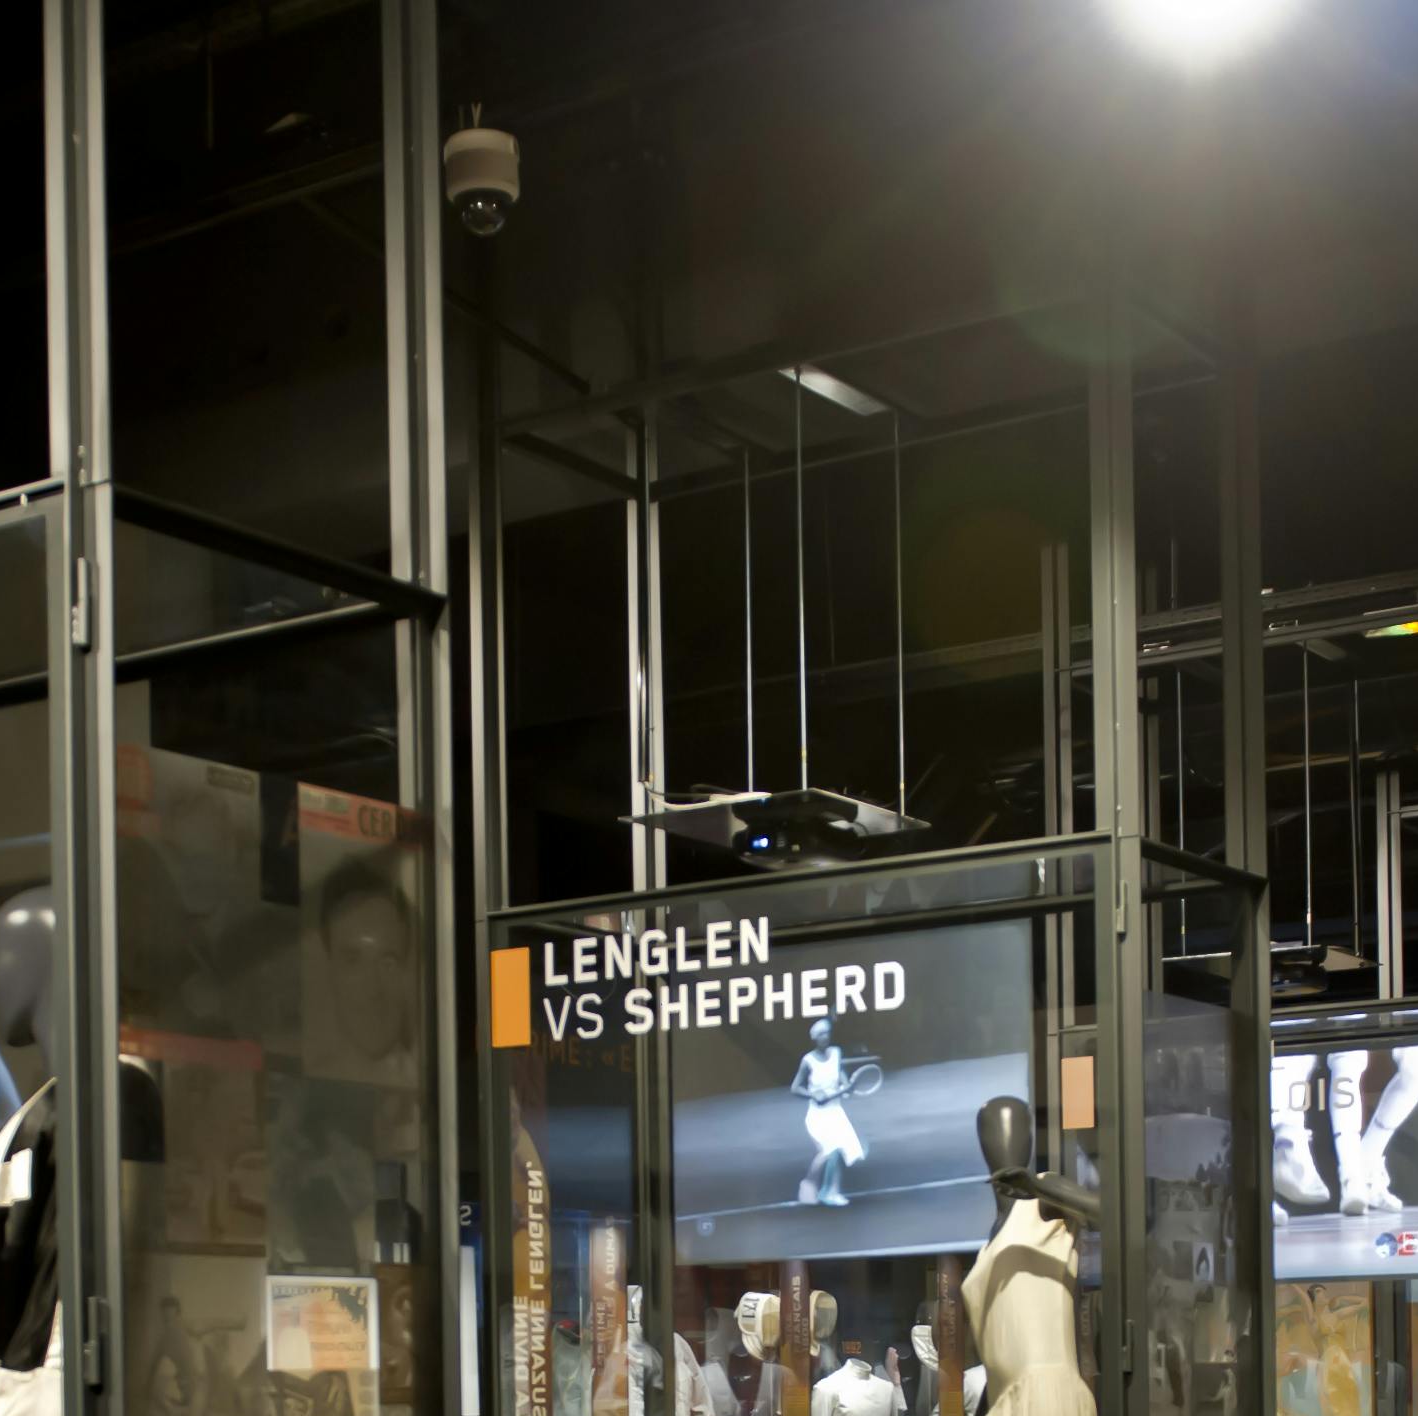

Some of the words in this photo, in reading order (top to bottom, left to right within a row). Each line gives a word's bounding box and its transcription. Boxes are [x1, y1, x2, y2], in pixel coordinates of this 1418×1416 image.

[543, 916, 770, 987] LENGLEN
[543, 993, 604, 1042] VS
[624, 960, 906, 1036] SHEPHERD
